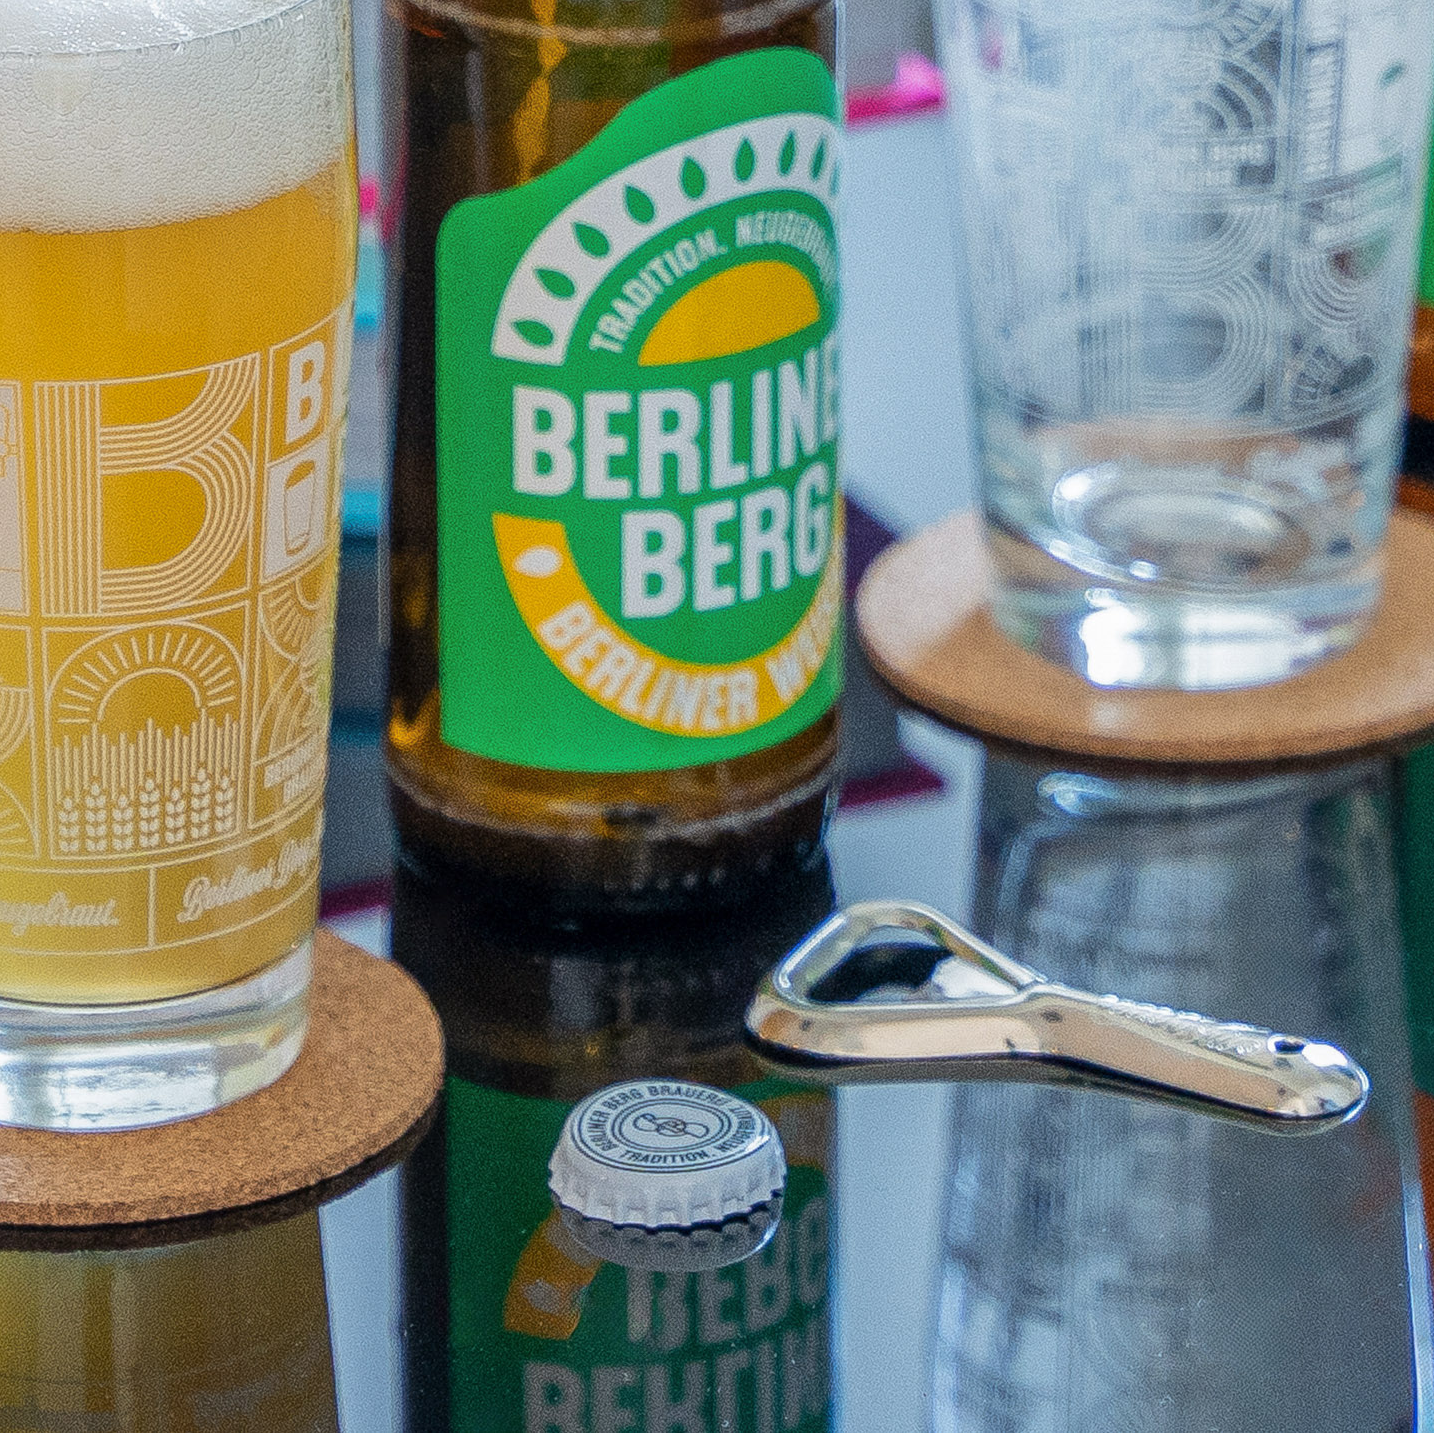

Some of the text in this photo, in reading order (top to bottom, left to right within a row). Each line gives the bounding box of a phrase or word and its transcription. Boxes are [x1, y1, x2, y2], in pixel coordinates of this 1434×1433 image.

[588, 227, 729, 355] TRADITION.
[286, 340, 324, 445] B
[621, 459, 830, 620] BERG
[536, 600, 760, 732] BERLINER
[602, 1087, 644, 1112] BERG
